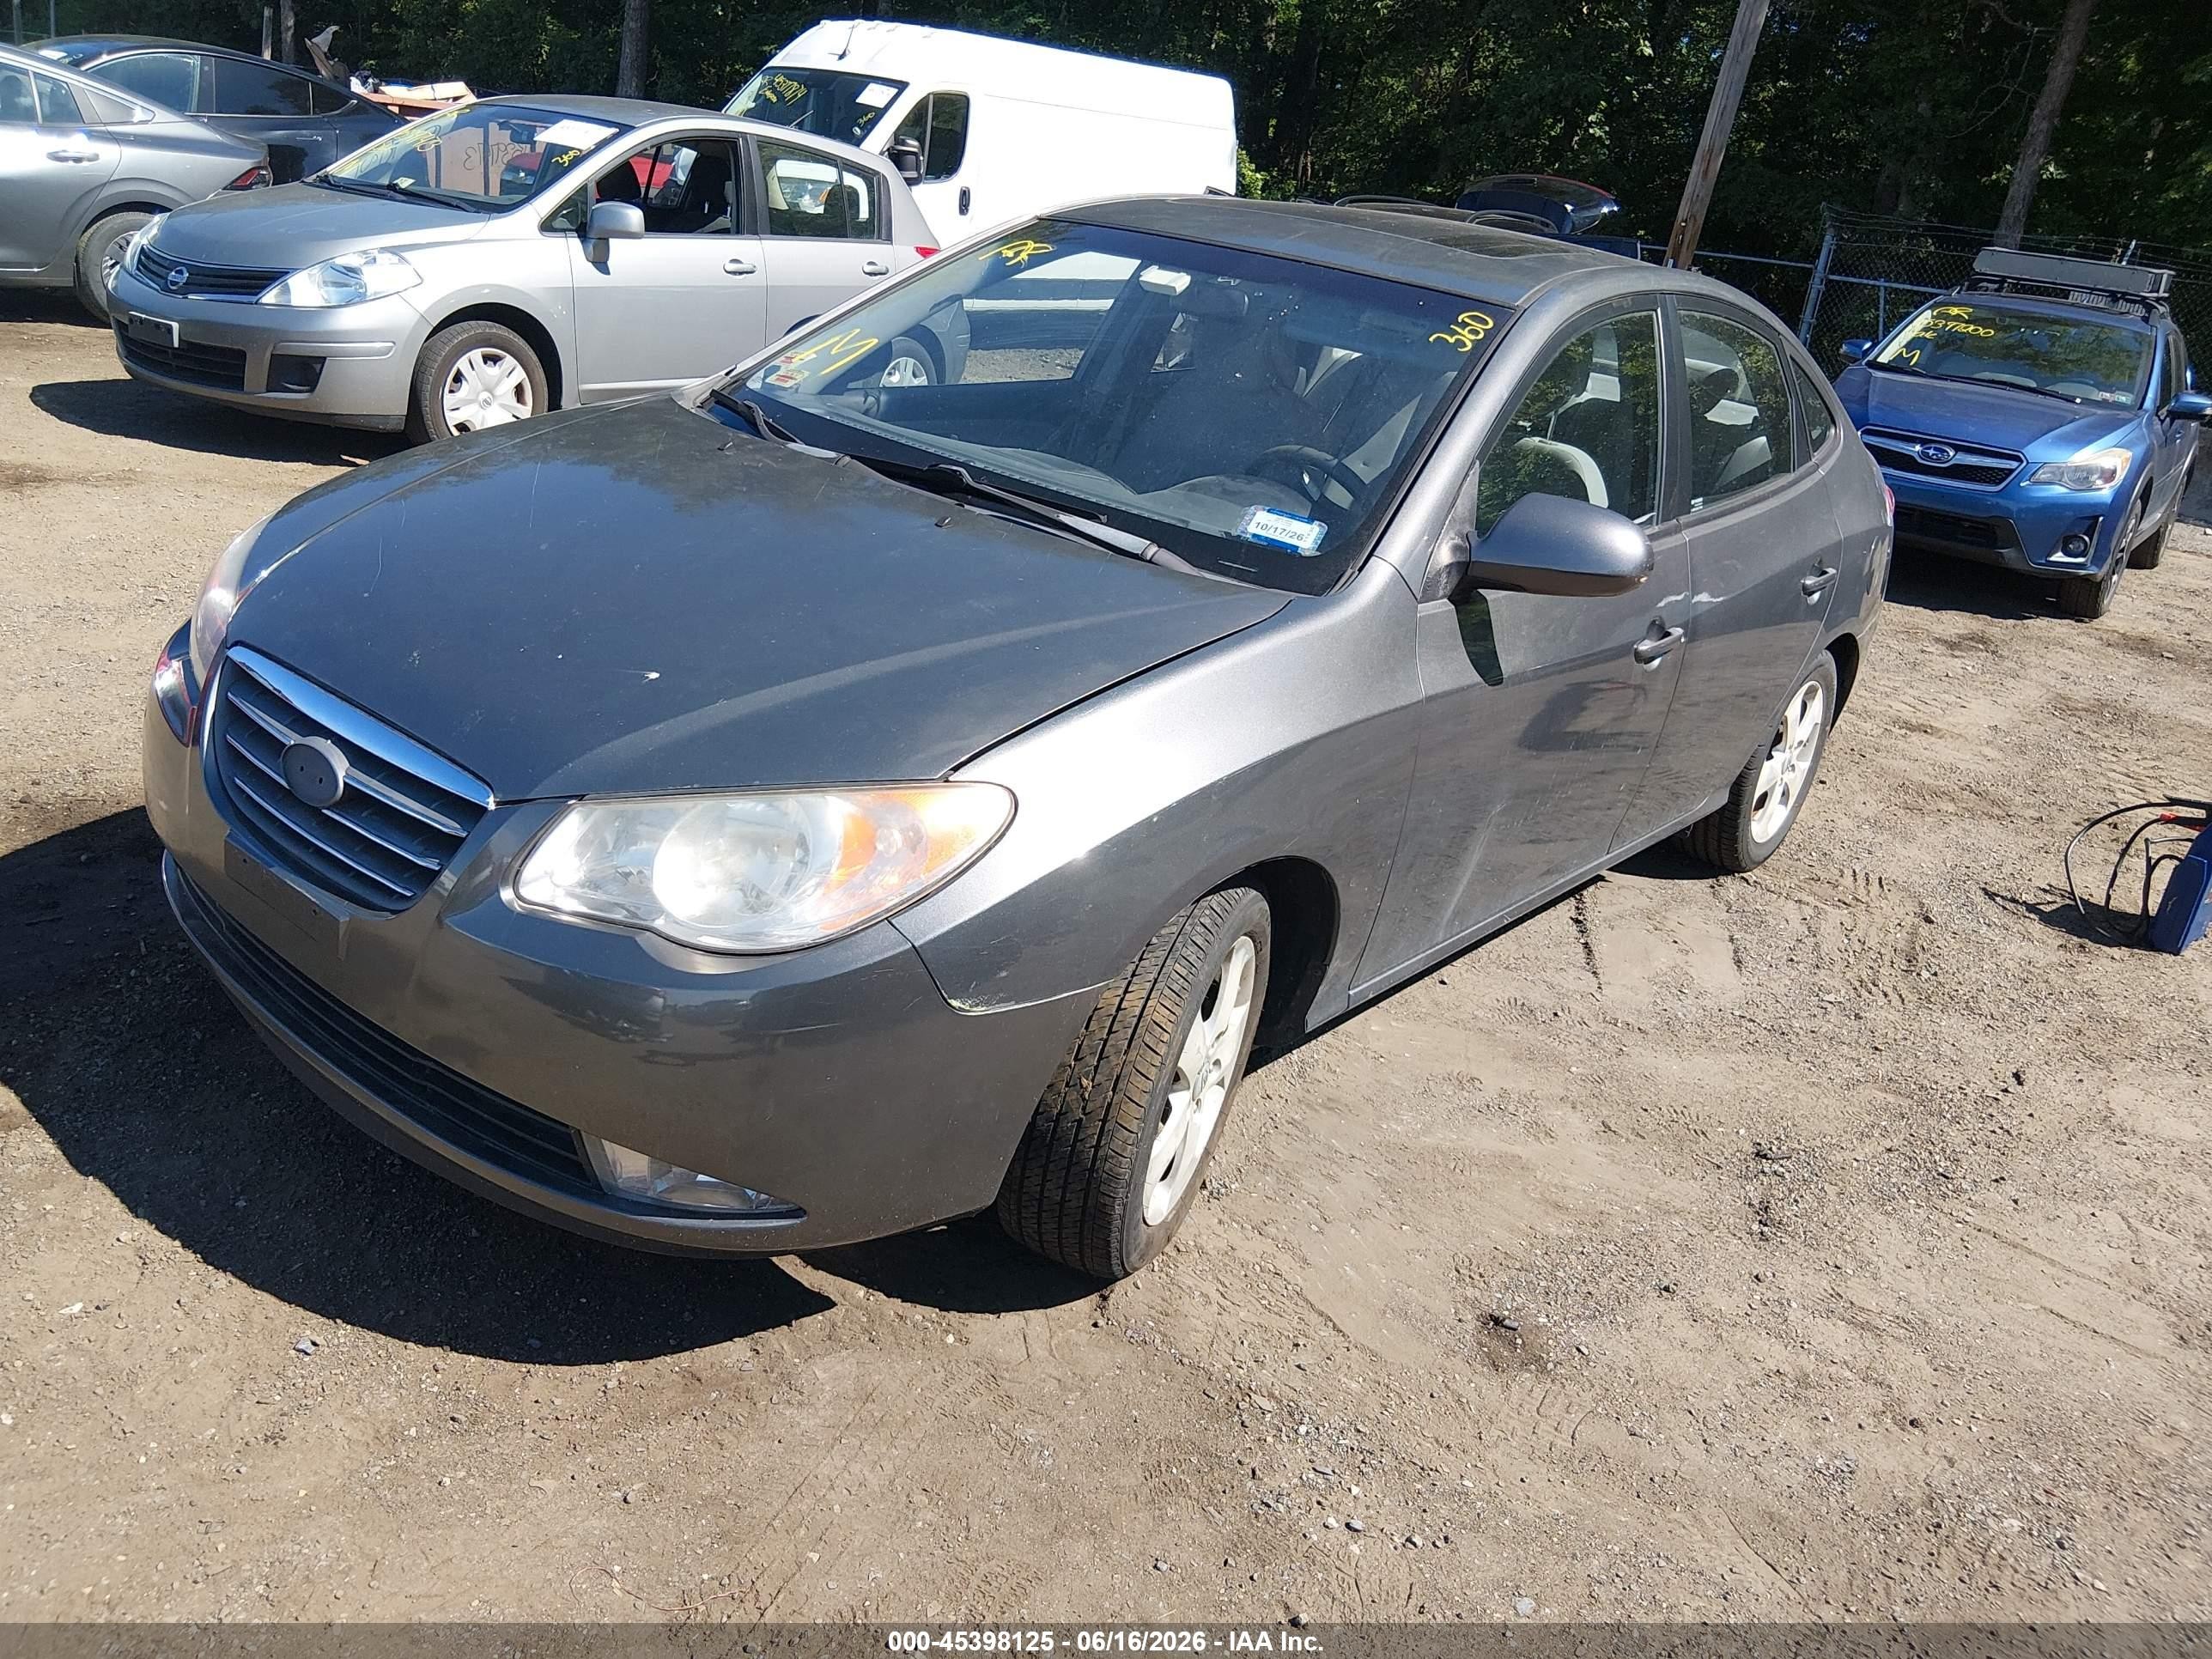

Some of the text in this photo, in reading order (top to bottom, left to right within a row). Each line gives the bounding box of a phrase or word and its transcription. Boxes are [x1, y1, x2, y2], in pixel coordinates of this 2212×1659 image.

[1428, 312, 1494, 352] 360
[1889, 347, 1921, 367] M
[1255, 521, 1304, 542] 10/17/26
